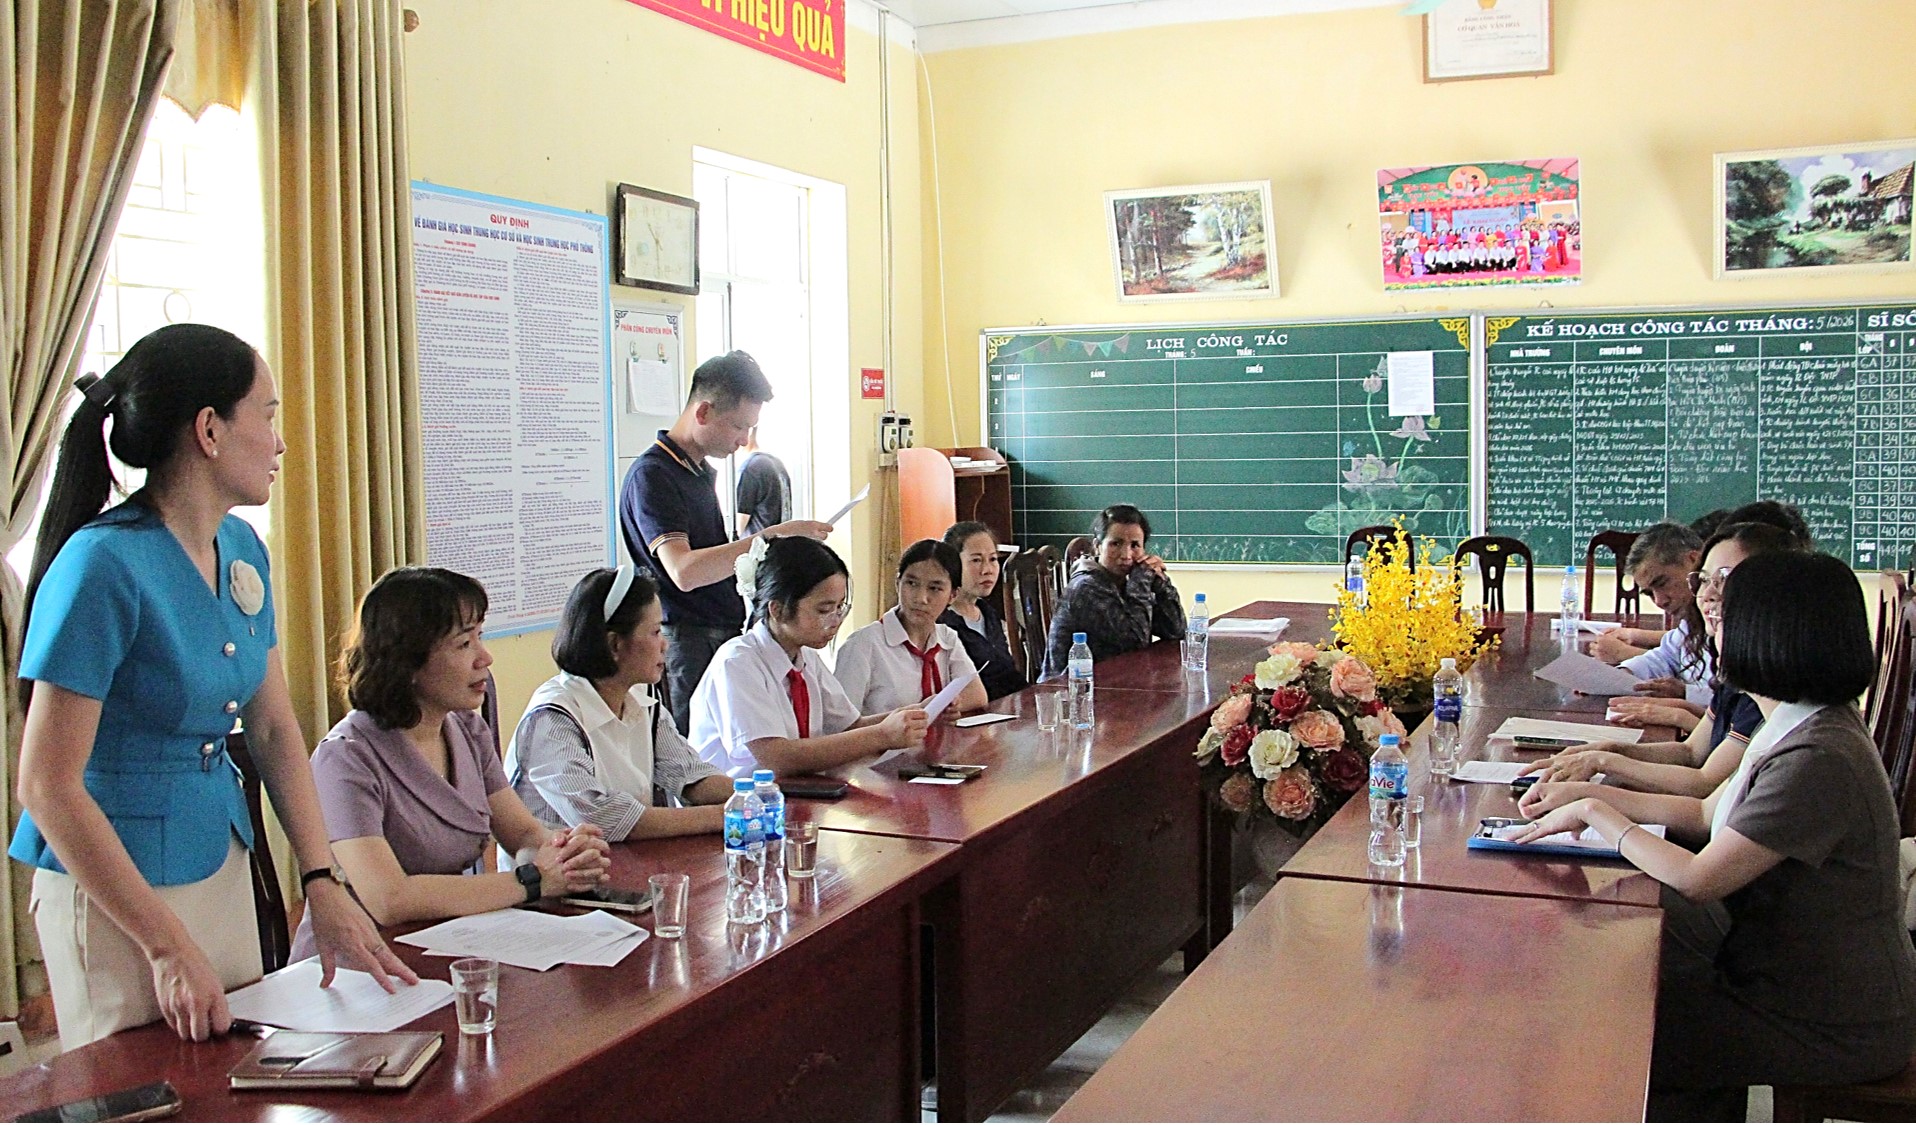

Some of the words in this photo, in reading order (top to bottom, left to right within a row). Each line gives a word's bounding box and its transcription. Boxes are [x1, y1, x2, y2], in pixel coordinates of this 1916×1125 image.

[792, 0, 835, 59] QUẢ
[490, 213, 507, 225] QUY
[510, 217, 529, 229] ĐỊNH
[448, 222, 458, 235] HỌC
[460, 224, 472, 236] SINH
[1867, 313, 1889, 327] SĨ
[1527, 319, 1553, 337] KẾ
[1558, 323, 1625, 339] HOẠCH
[1630, 318, 1685, 335] CÔNG
[1689, 316, 1728, 333] TÁC
[1735, 315, 1814, 332] THÁNG:
[1146, 338, 1185, 353] LỊCH
[1197, 333, 1244, 348] CÔNG
[1254, 330, 1288, 346] TÁC
[1190, 349, 1197, 358] 5
[1860, 357, 1877, 369] 6A
[1884, 356, 1897, 368] 37
[1859, 373, 1878, 385] 6B
[1884, 372, 1897, 383] 37
[1860, 388, 1876, 400] 6C
[1884, 387, 1898, 400] 36
[1862, 404, 1878, 415] 7A
[1883, 403, 1898, 415] 33
[1861, 418, 1878, 430] 7B
[1883, 417, 1897, 430] 36
[1860, 433, 1875, 445] 7C
[1884, 433, 1898, 446] 34
[1883, 449, 1897, 460] 39
[1902, 448, 1915, 461] 39
[1882, 464, 1897, 476] 40
[1901, 466, 1916, 475] 40
[1883, 480, 1896, 492] 37
[1858, 495, 1874, 505] 9A
[1882, 495, 1897, 506] 39
[1882, 510, 1897, 521] 40
[1901, 511, 1915, 521] 40
[1858, 525, 1874, 535] 9C
[1881, 525, 1896, 537] 40
[1900, 526, 1915, 537] 40
[1856, 539, 1876, 551] TỔNG
[1859, 552, 1871, 562] SỐ
[1371, 776, 1394, 788] aVie
